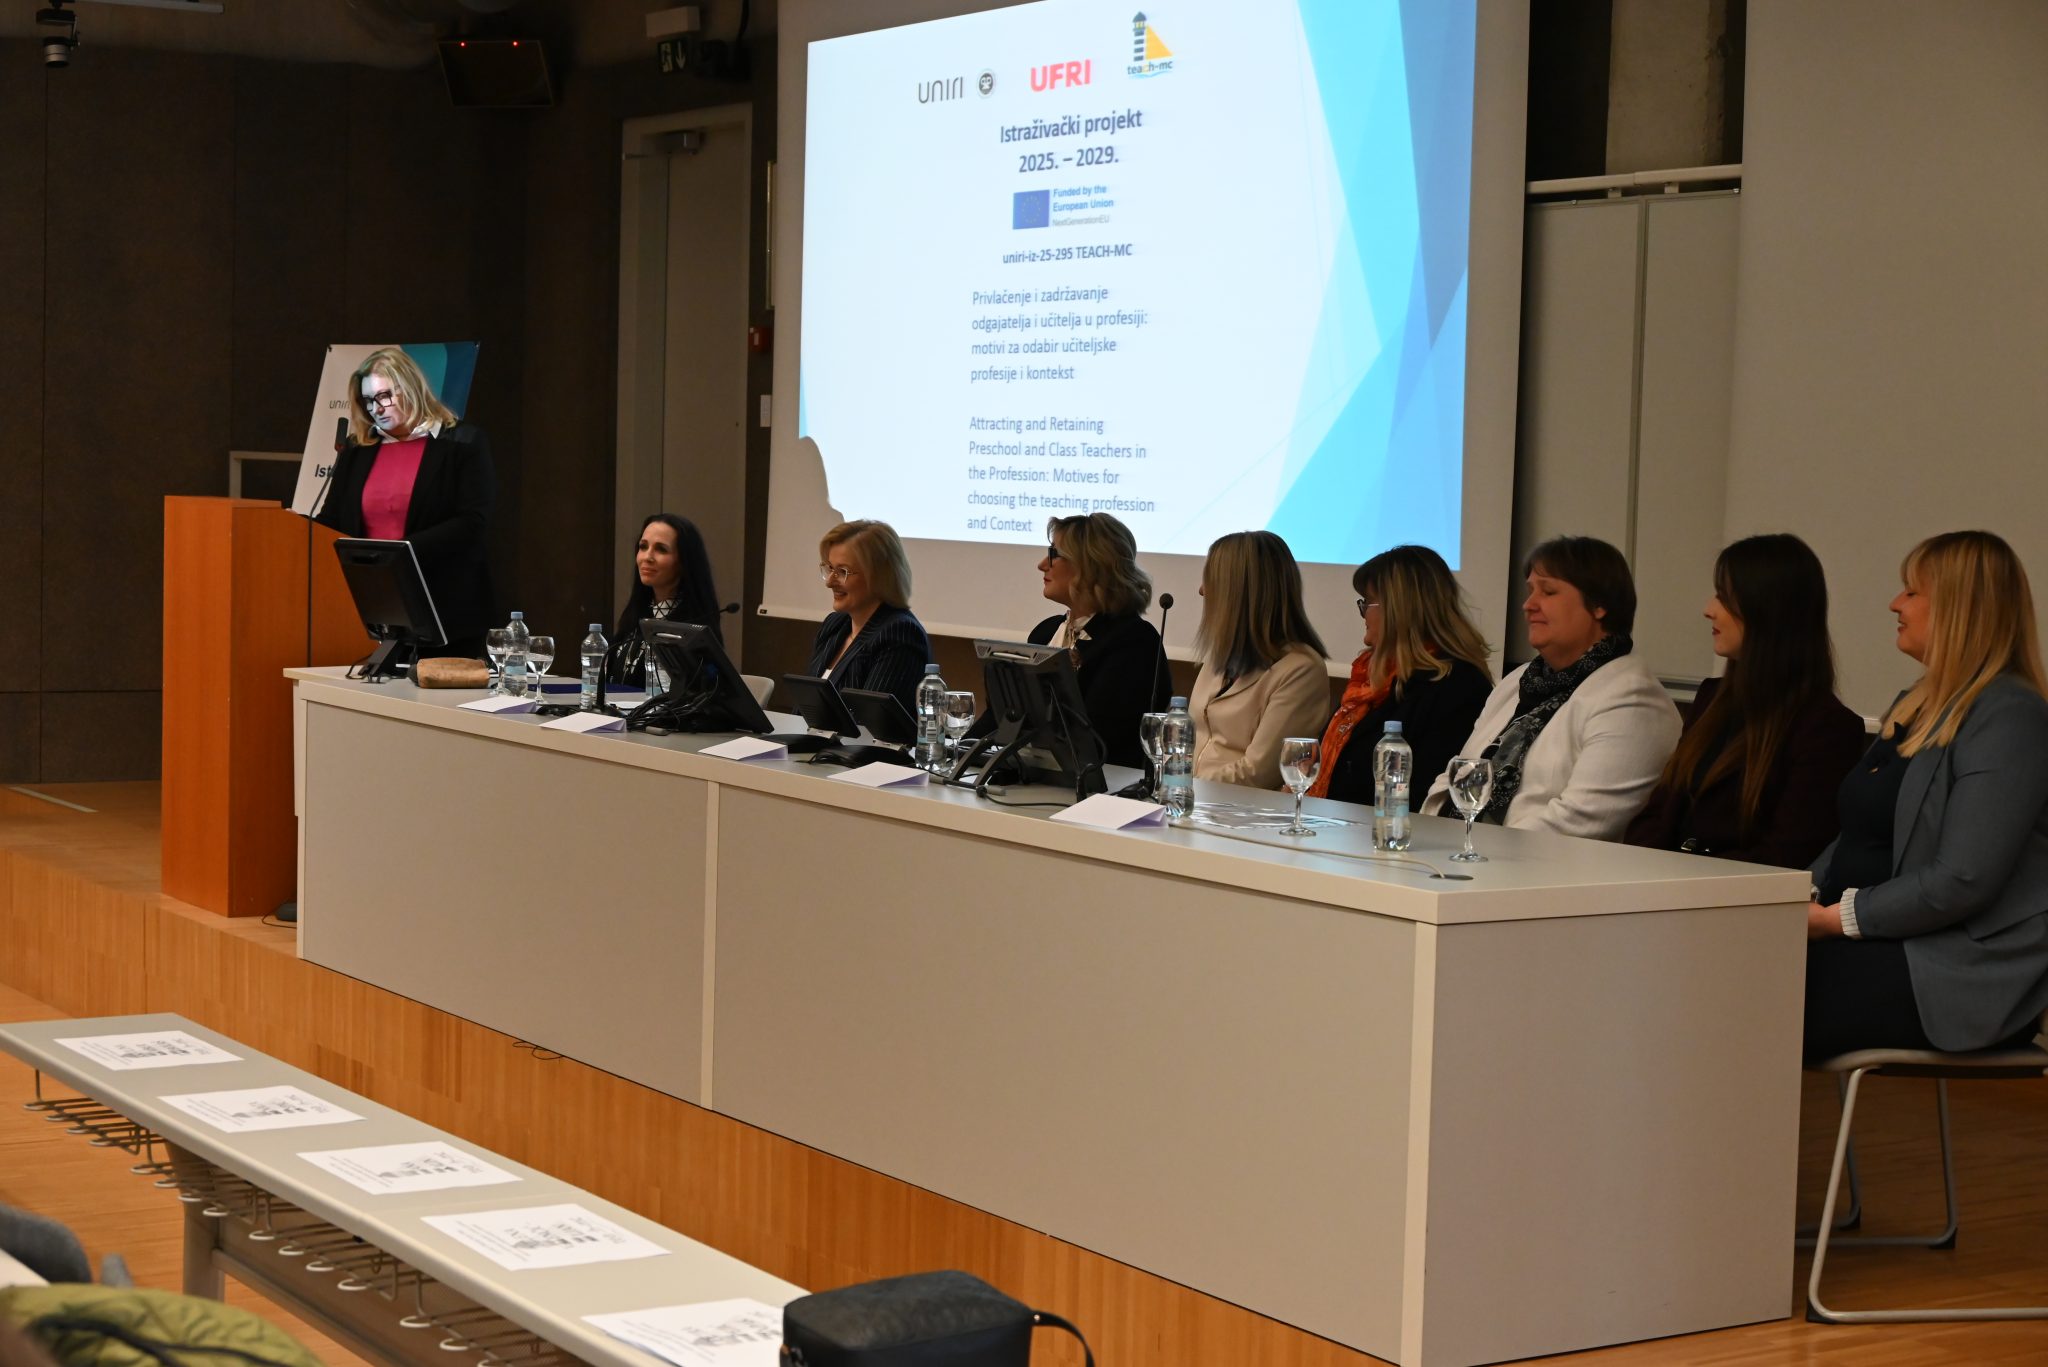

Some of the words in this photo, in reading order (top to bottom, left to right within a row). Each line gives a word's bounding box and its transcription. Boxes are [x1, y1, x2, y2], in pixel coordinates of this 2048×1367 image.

[1030, 59, 1091, 92] UFRI
[1000, 114, 1080, 143] Istraživački
[1085, 108, 1142, 138] projekt
[1019, 152, 1058, 173] 2025.
[1077, 146, 1119, 167] 2029.
[1053, 187, 1080, 197] Funded
[1083, 186, 1092, 197] by
[1094, 185, 1107, 194] the
[1053, 202, 1088, 212] European
[1091, 199, 1113, 208] Union
[1002, 246, 1073, 264] uniri-iz-25-295
[1076, 243, 1132, 259] TEACH-MC
[972, 289, 1031, 306] Privlačenje
[1041, 285, 1108, 302] zadržavanje
[972, 314, 1031, 333] odgajatelja
[1040, 312, 1081, 330] učitelja
[1085, 314, 1092, 326] u
[1096, 309, 1148, 328] profesiji:
[972, 341, 1005, 355] motivi
[1008, 343, 1019, 354] za
[1022, 339, 1059, 353] odabir
[1062, 337, 1116, 355] učiteljske
[971, 367, 1017, 383] profesije
[1027, 366, 1074, 380] kontekst
[970, 417, 1022, 434] Attracting
[1025, 417, 1046, 431] and
[1049, 417, 1104, 434] Retaining
[969, 441, 1021, 455] Preschool
[1024, 442, 1045, 456] and
[1049, 442, 1077, 457] Class
[1081, 443, 1132, 458] Teachers
[1135, 445, 1146, 458] in
[969, 466, 986, 479] the
[989, 466, 1049, 482] Profession:
[1053, 468, 1099, 483] Motives
[1103, 469, 1120, 484] for
[968, 491, 1015, 508] choosing
[1019, 492, 1037, 506] the
[1040, 495, 1089, 512] teaching
[1093, 496, 1154, 515] profession
[967, 516, 987, 529] and
[990, 517, 1032, 532] Context
